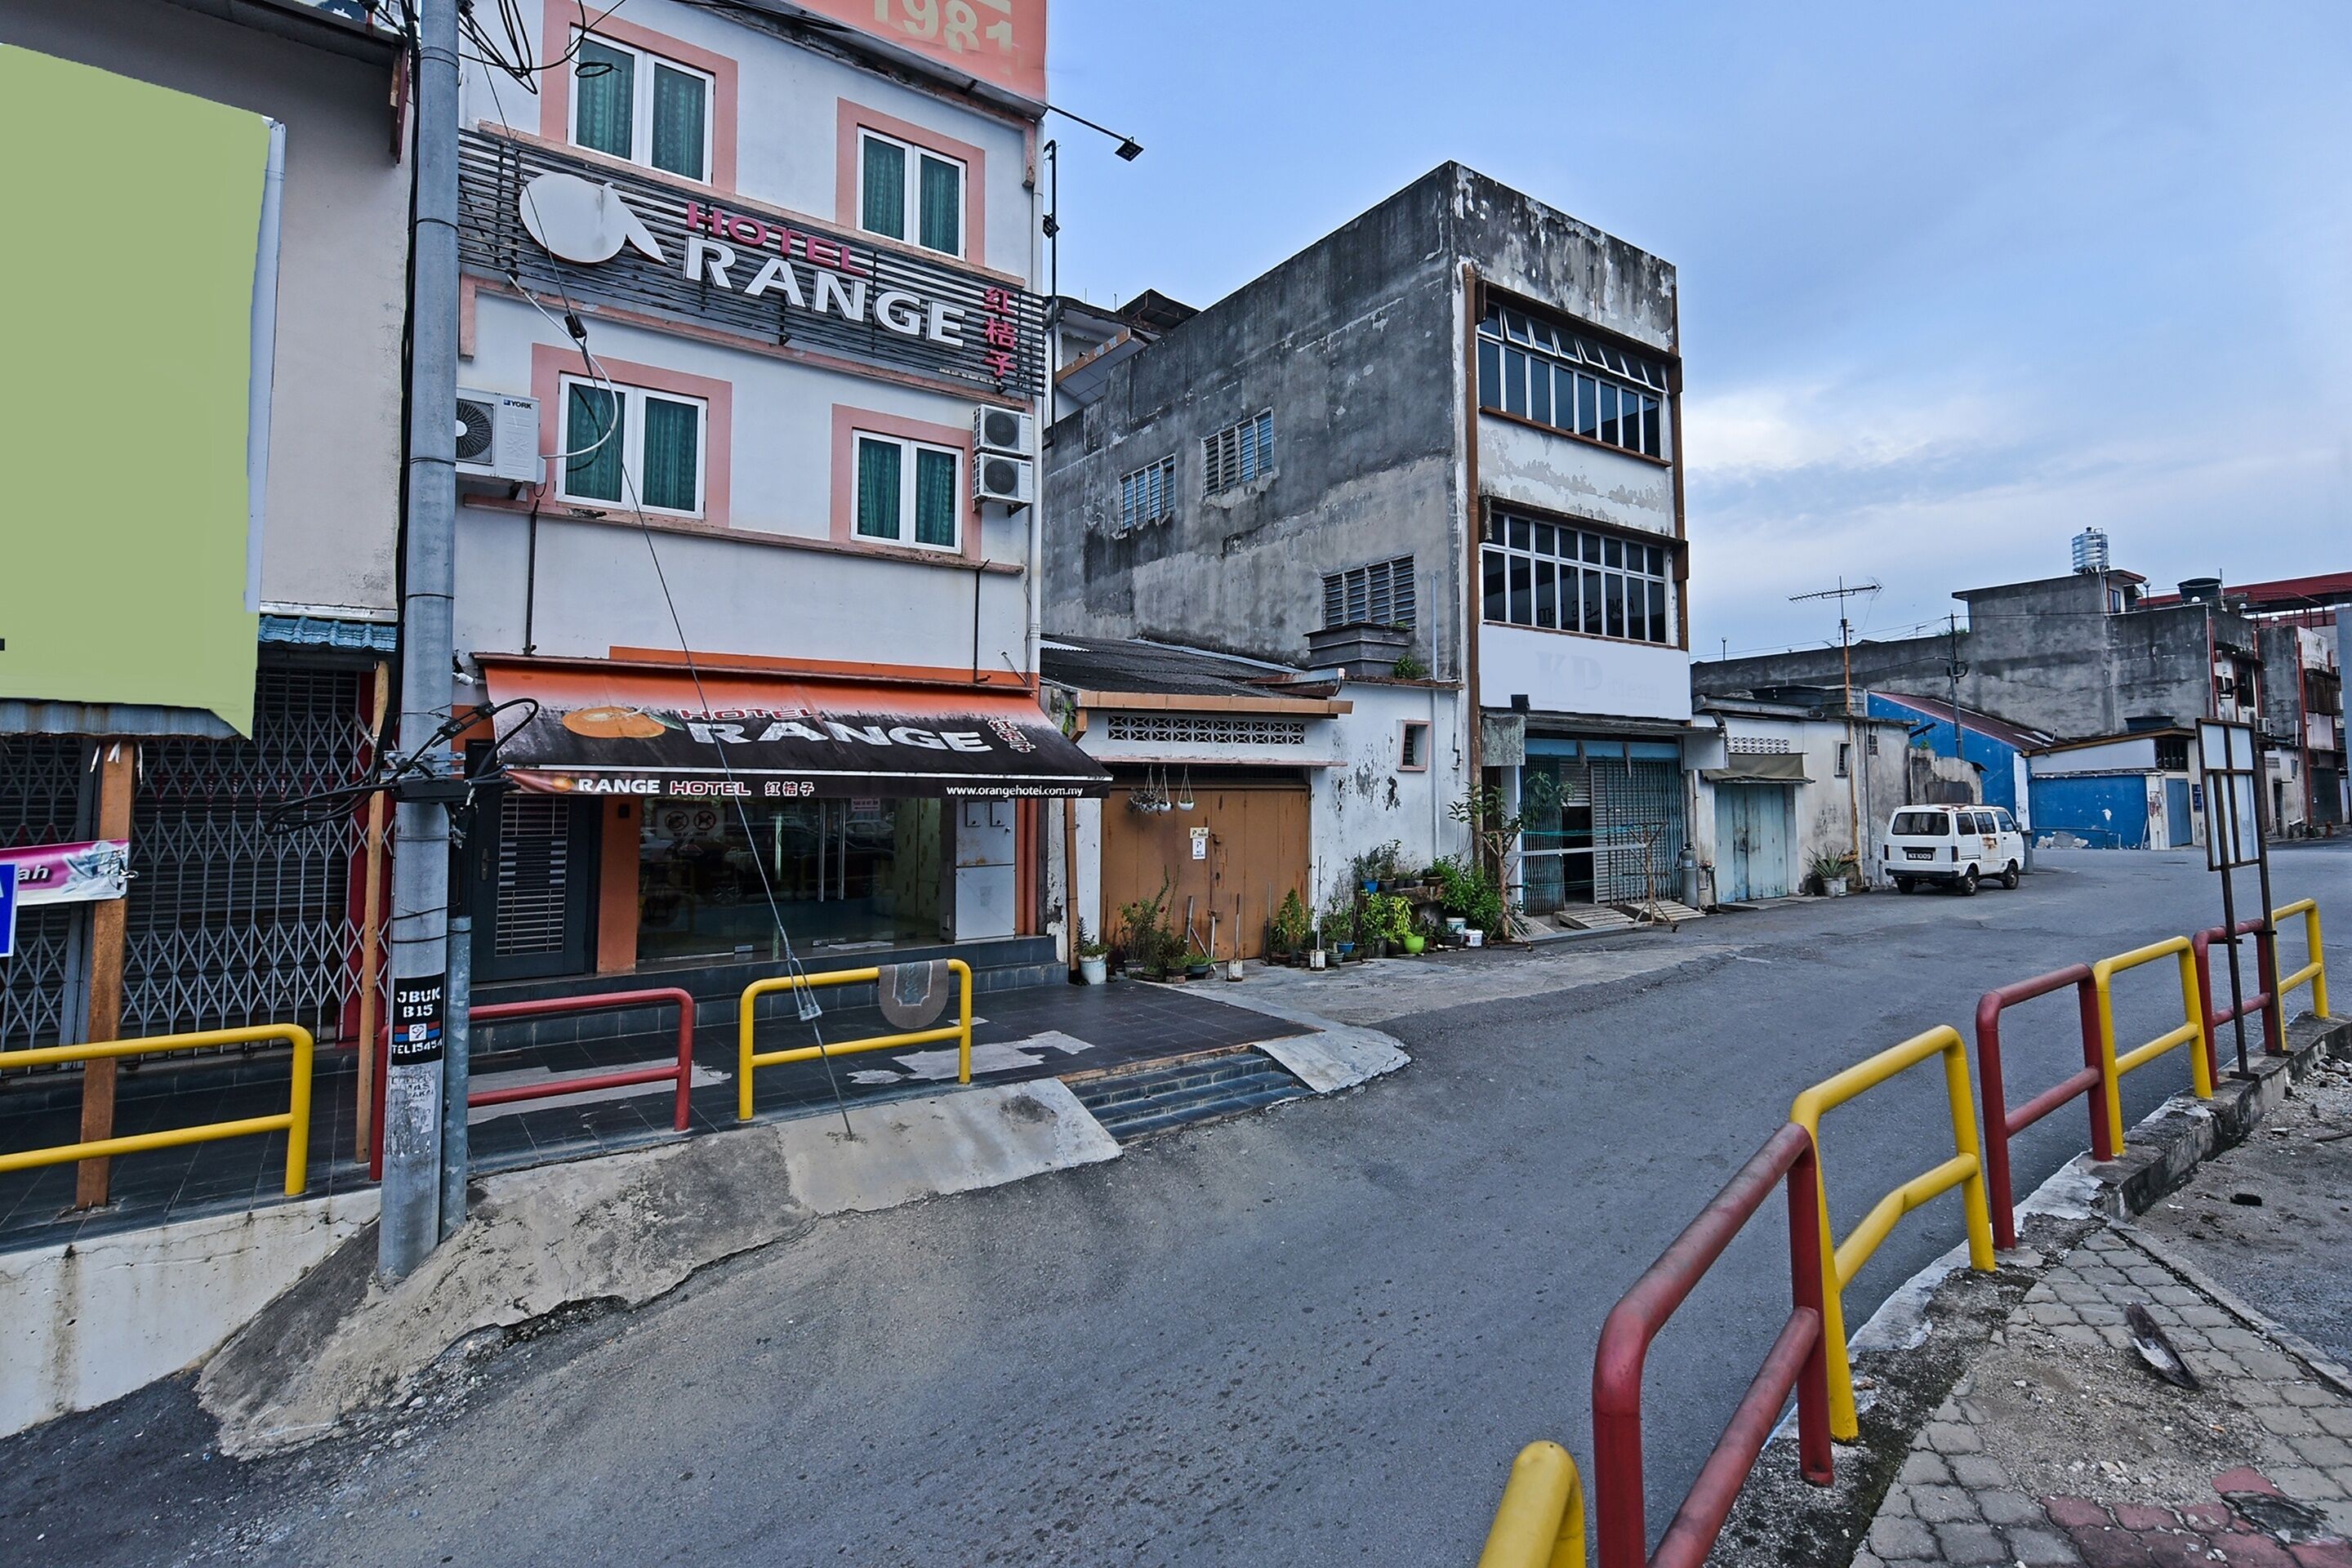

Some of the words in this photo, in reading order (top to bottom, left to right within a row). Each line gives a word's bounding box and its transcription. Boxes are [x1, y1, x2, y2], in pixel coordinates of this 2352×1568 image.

[687, 202, 867, 276] HOTEL
[983, 286, 1018, 377] 红桔子
[510, 400, 532, 409] YORK
[679, 708, 817, 720] HOTEL
[670, 781, 752, 795] HOTEL
[764, 782, 815, 796] 红桔子
[946, 784, 1084, 798] www.orangehotel.com.my
